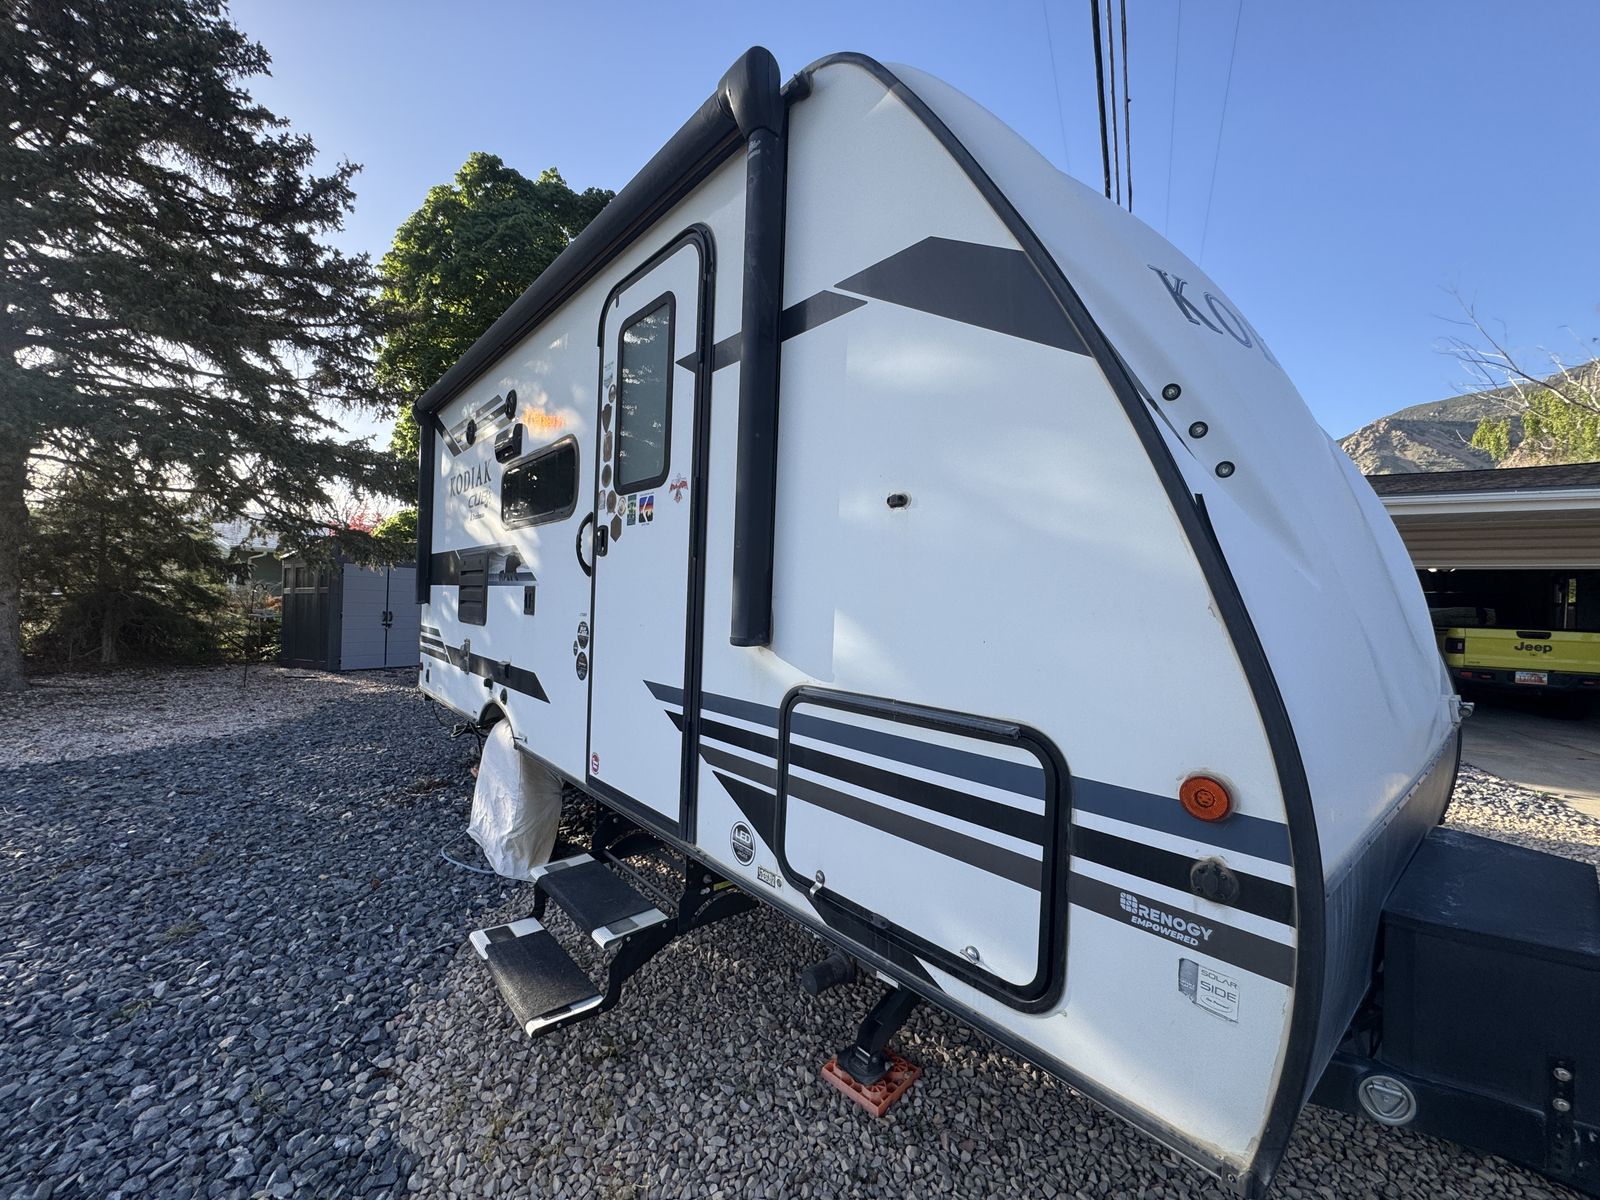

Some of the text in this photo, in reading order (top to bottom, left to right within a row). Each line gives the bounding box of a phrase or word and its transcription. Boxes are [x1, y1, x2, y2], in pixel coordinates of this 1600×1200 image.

[449, 459, 492, 498] KODIAK
[1513, 641, 1553, 654] Jeep
[735, 828, 751, 844] LED
[1131, 915, 1199, 947] EMPOWERED
[1138, 904, 1213, 941] RENOGY
[1200, 969, 1238, 990] SOLAR
[1200, 980, 1237, 1004] SIDE
